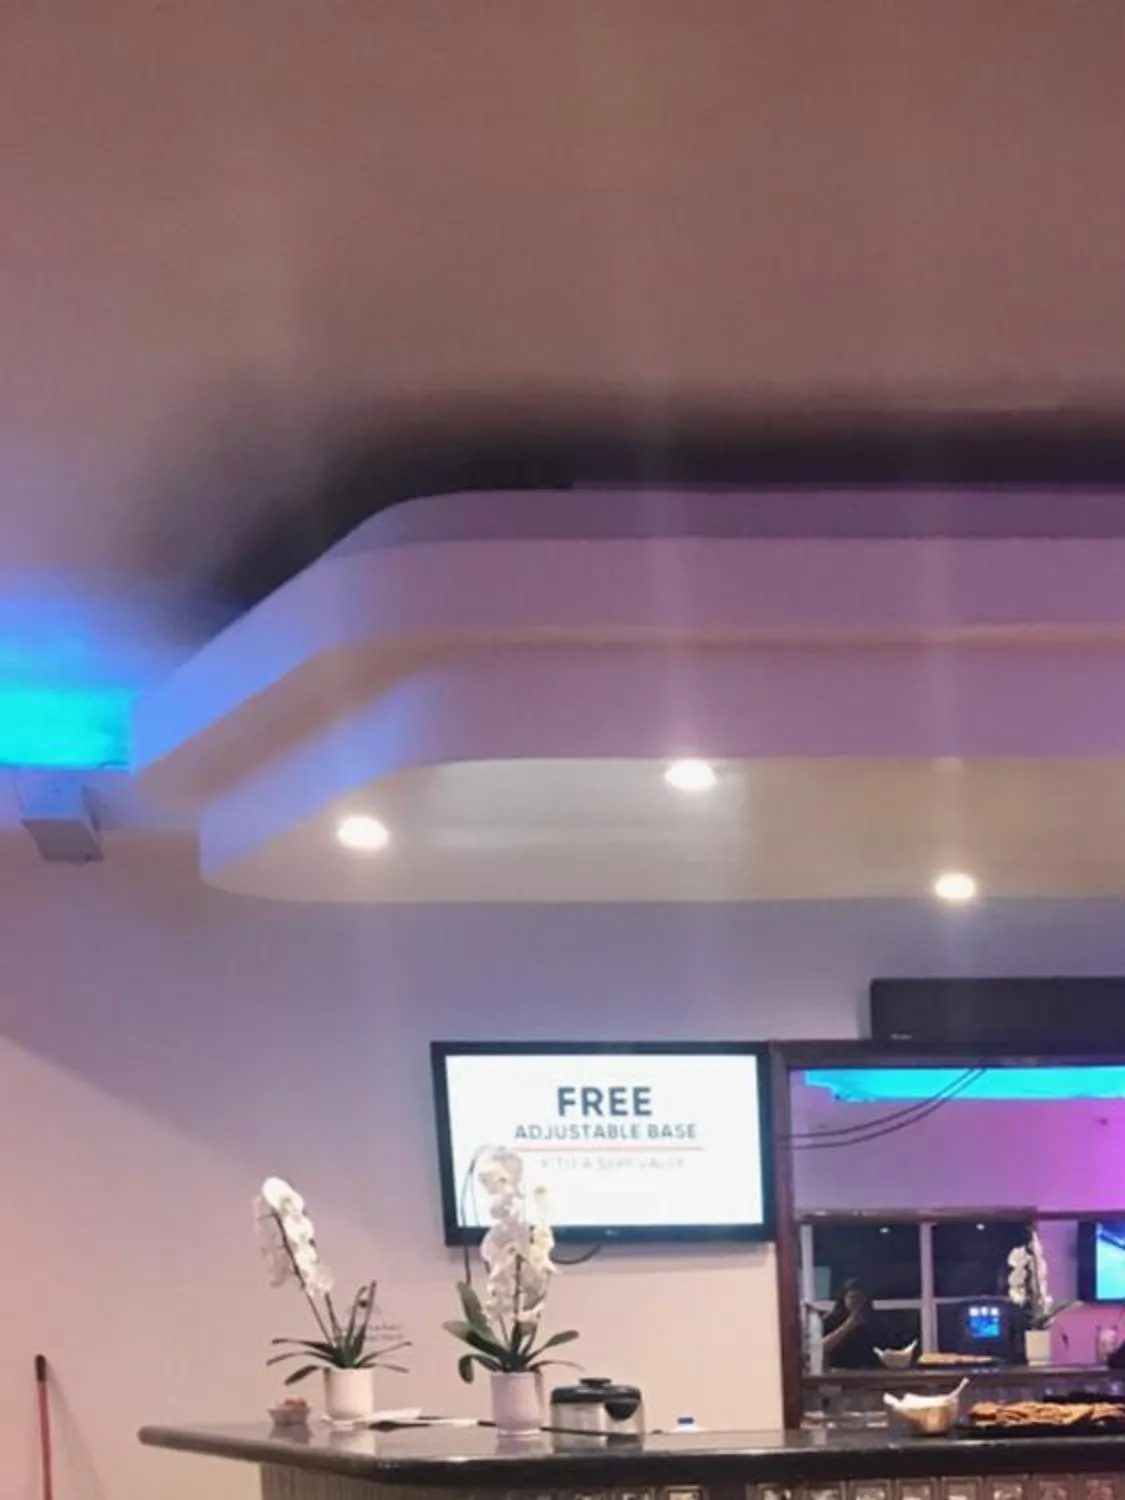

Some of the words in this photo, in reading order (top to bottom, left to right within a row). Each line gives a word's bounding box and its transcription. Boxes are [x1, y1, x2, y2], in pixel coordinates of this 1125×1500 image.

[556, 1085, 654, 1118] FREE
[514, 1123, 640, 1140] ADJUSTABLE
[647, 1123, 697, 1140] BASE
